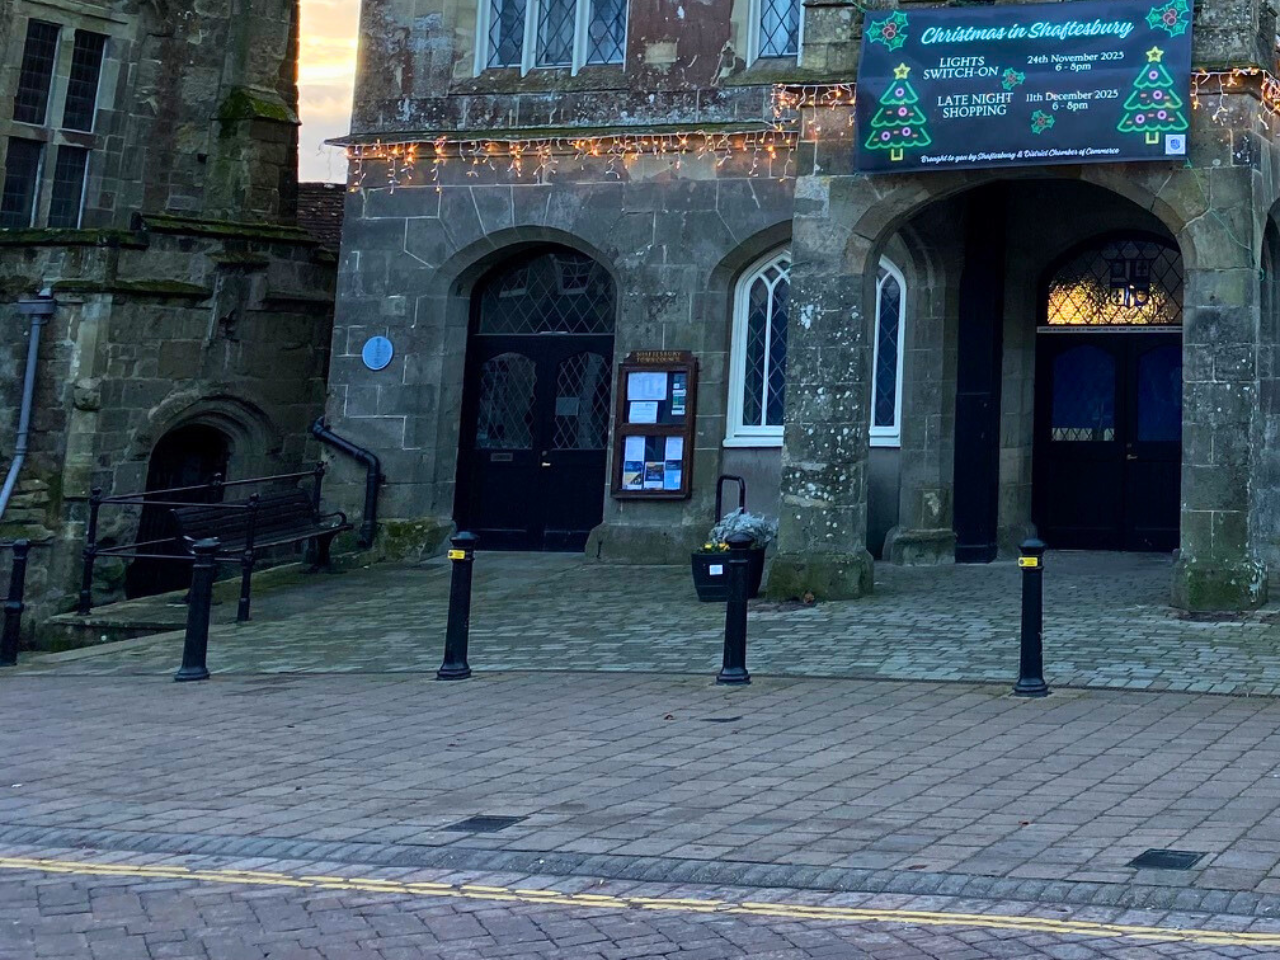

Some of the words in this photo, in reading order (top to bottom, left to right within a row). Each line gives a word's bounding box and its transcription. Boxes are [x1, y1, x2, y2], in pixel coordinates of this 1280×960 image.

[921, 26, 1007, 45] Christmas
[1008, 23, 1027, 39] in
[1027, 19, 1134, 40] Shaftesbury
[939, 56, 985, 68] LIGHTS
[1027, 54, 1049, 64] 24th
[1050, 53, 1099, 63] November
[1100, 51, 1125, 60] 2025
[923, 66, 999, 80] SWITCH-ON
[1069, 62, 1092, 72] 8pm
[937, 94, 969, 107] LATE
[971, 92, 1014, 105] NIGHT
[1025, 93, 1043, 102] 11th
[1045, 91, 1092, 101] December
[1094, 89, 1119, 99] 2025
[943, 104, 1007, 119] SHOPPING
[1052, 102, 1059, 110] 6
[1066, 101, 1089, 112] 8pm
[921, 154, 947, 164] Brought
[954, 155, 968, 163] you
[968, 153, 977, 162] by
[977, 151, 1017, 160] Shaftesbury
[1016, 150, 1023, 158] &
[1024, 149, 1049, 158] District
[1049, 148, 1078, 156] Chamber
[1078, 148, 1086, 156] of
[1086, 146, 1120, 156] Commerce
